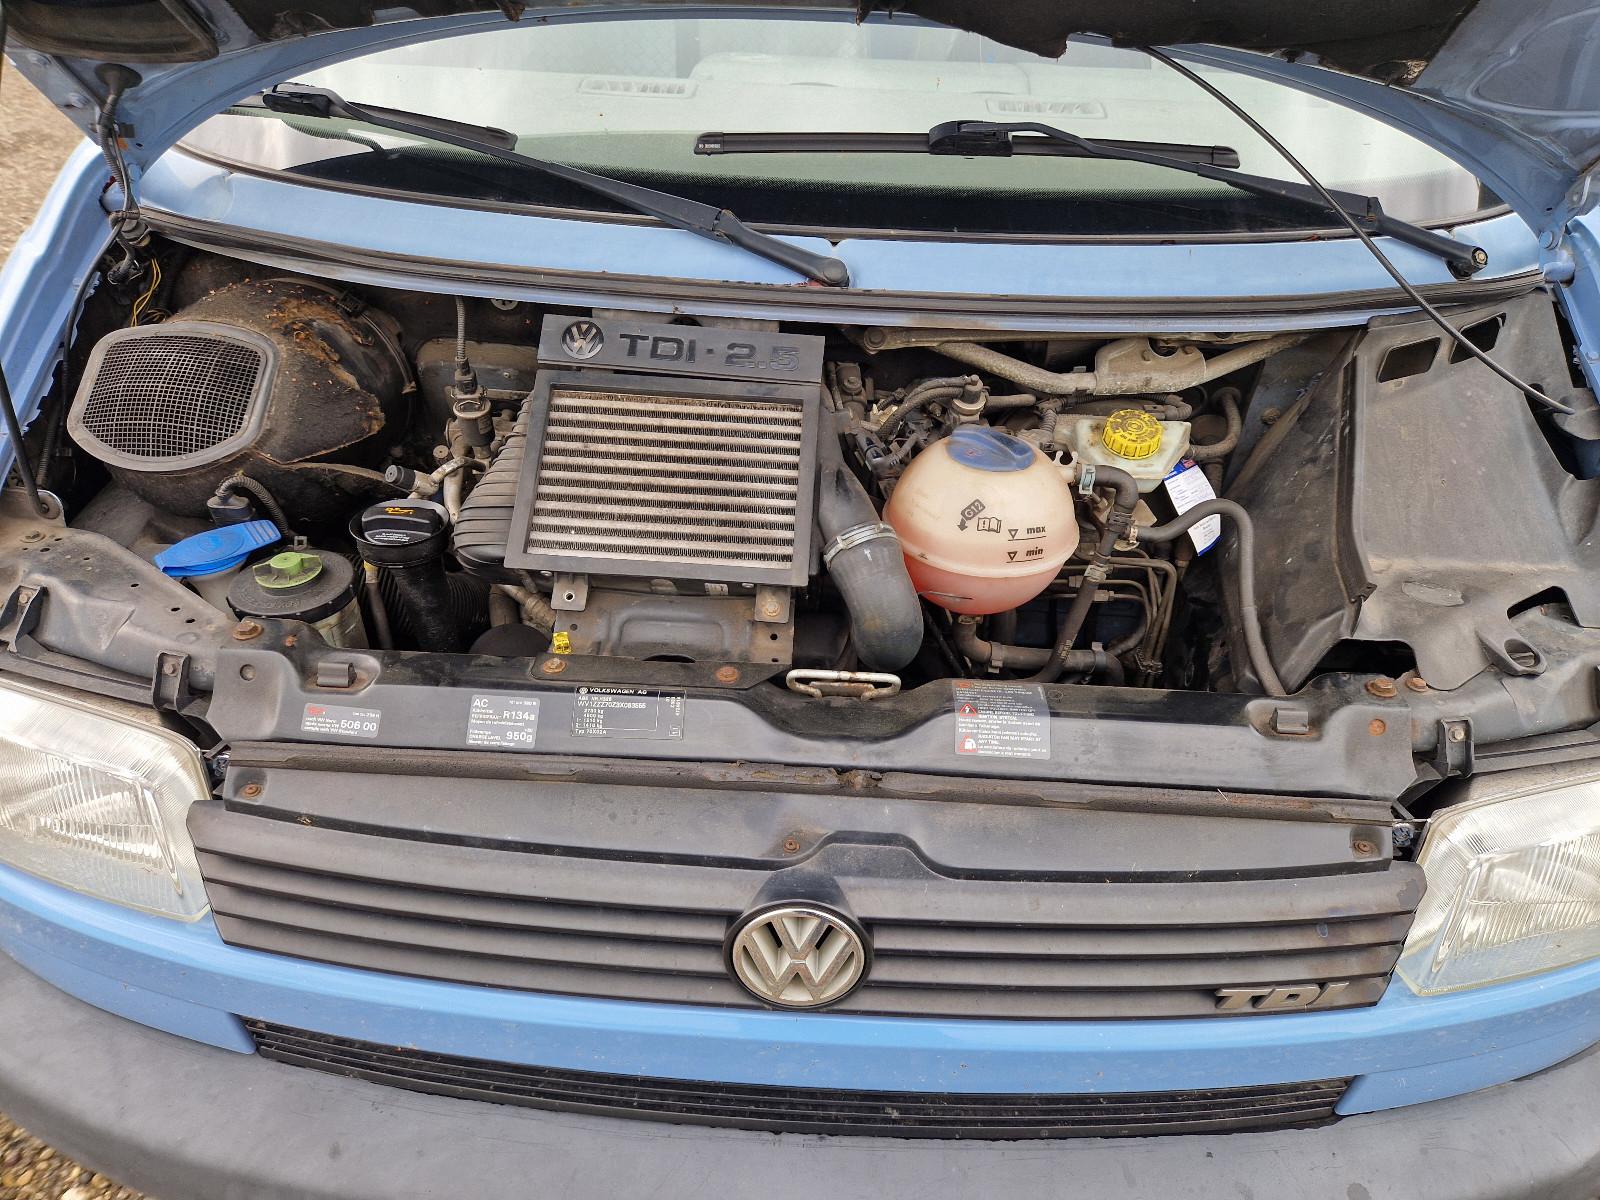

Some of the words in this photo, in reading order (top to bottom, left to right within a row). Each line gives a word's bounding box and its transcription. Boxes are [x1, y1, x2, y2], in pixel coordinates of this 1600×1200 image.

[619, 333, 697, 363] TDI
[725, 342, 800, 371] 2.5
[964, 503, 982, 518] G12
[1026, 526, 1046, 534] max
[1026, 546, 1044, 557] min
[589, 687, 635, 695] VOLKSWAGEN
[473, 698, 489, 708] AC
[502, 710, 535, 721] R134a
[363, 721, 377, 732] 00
[506, 731, 533, 743] 950g
[1215, 981, 1350, 1009] TDI
